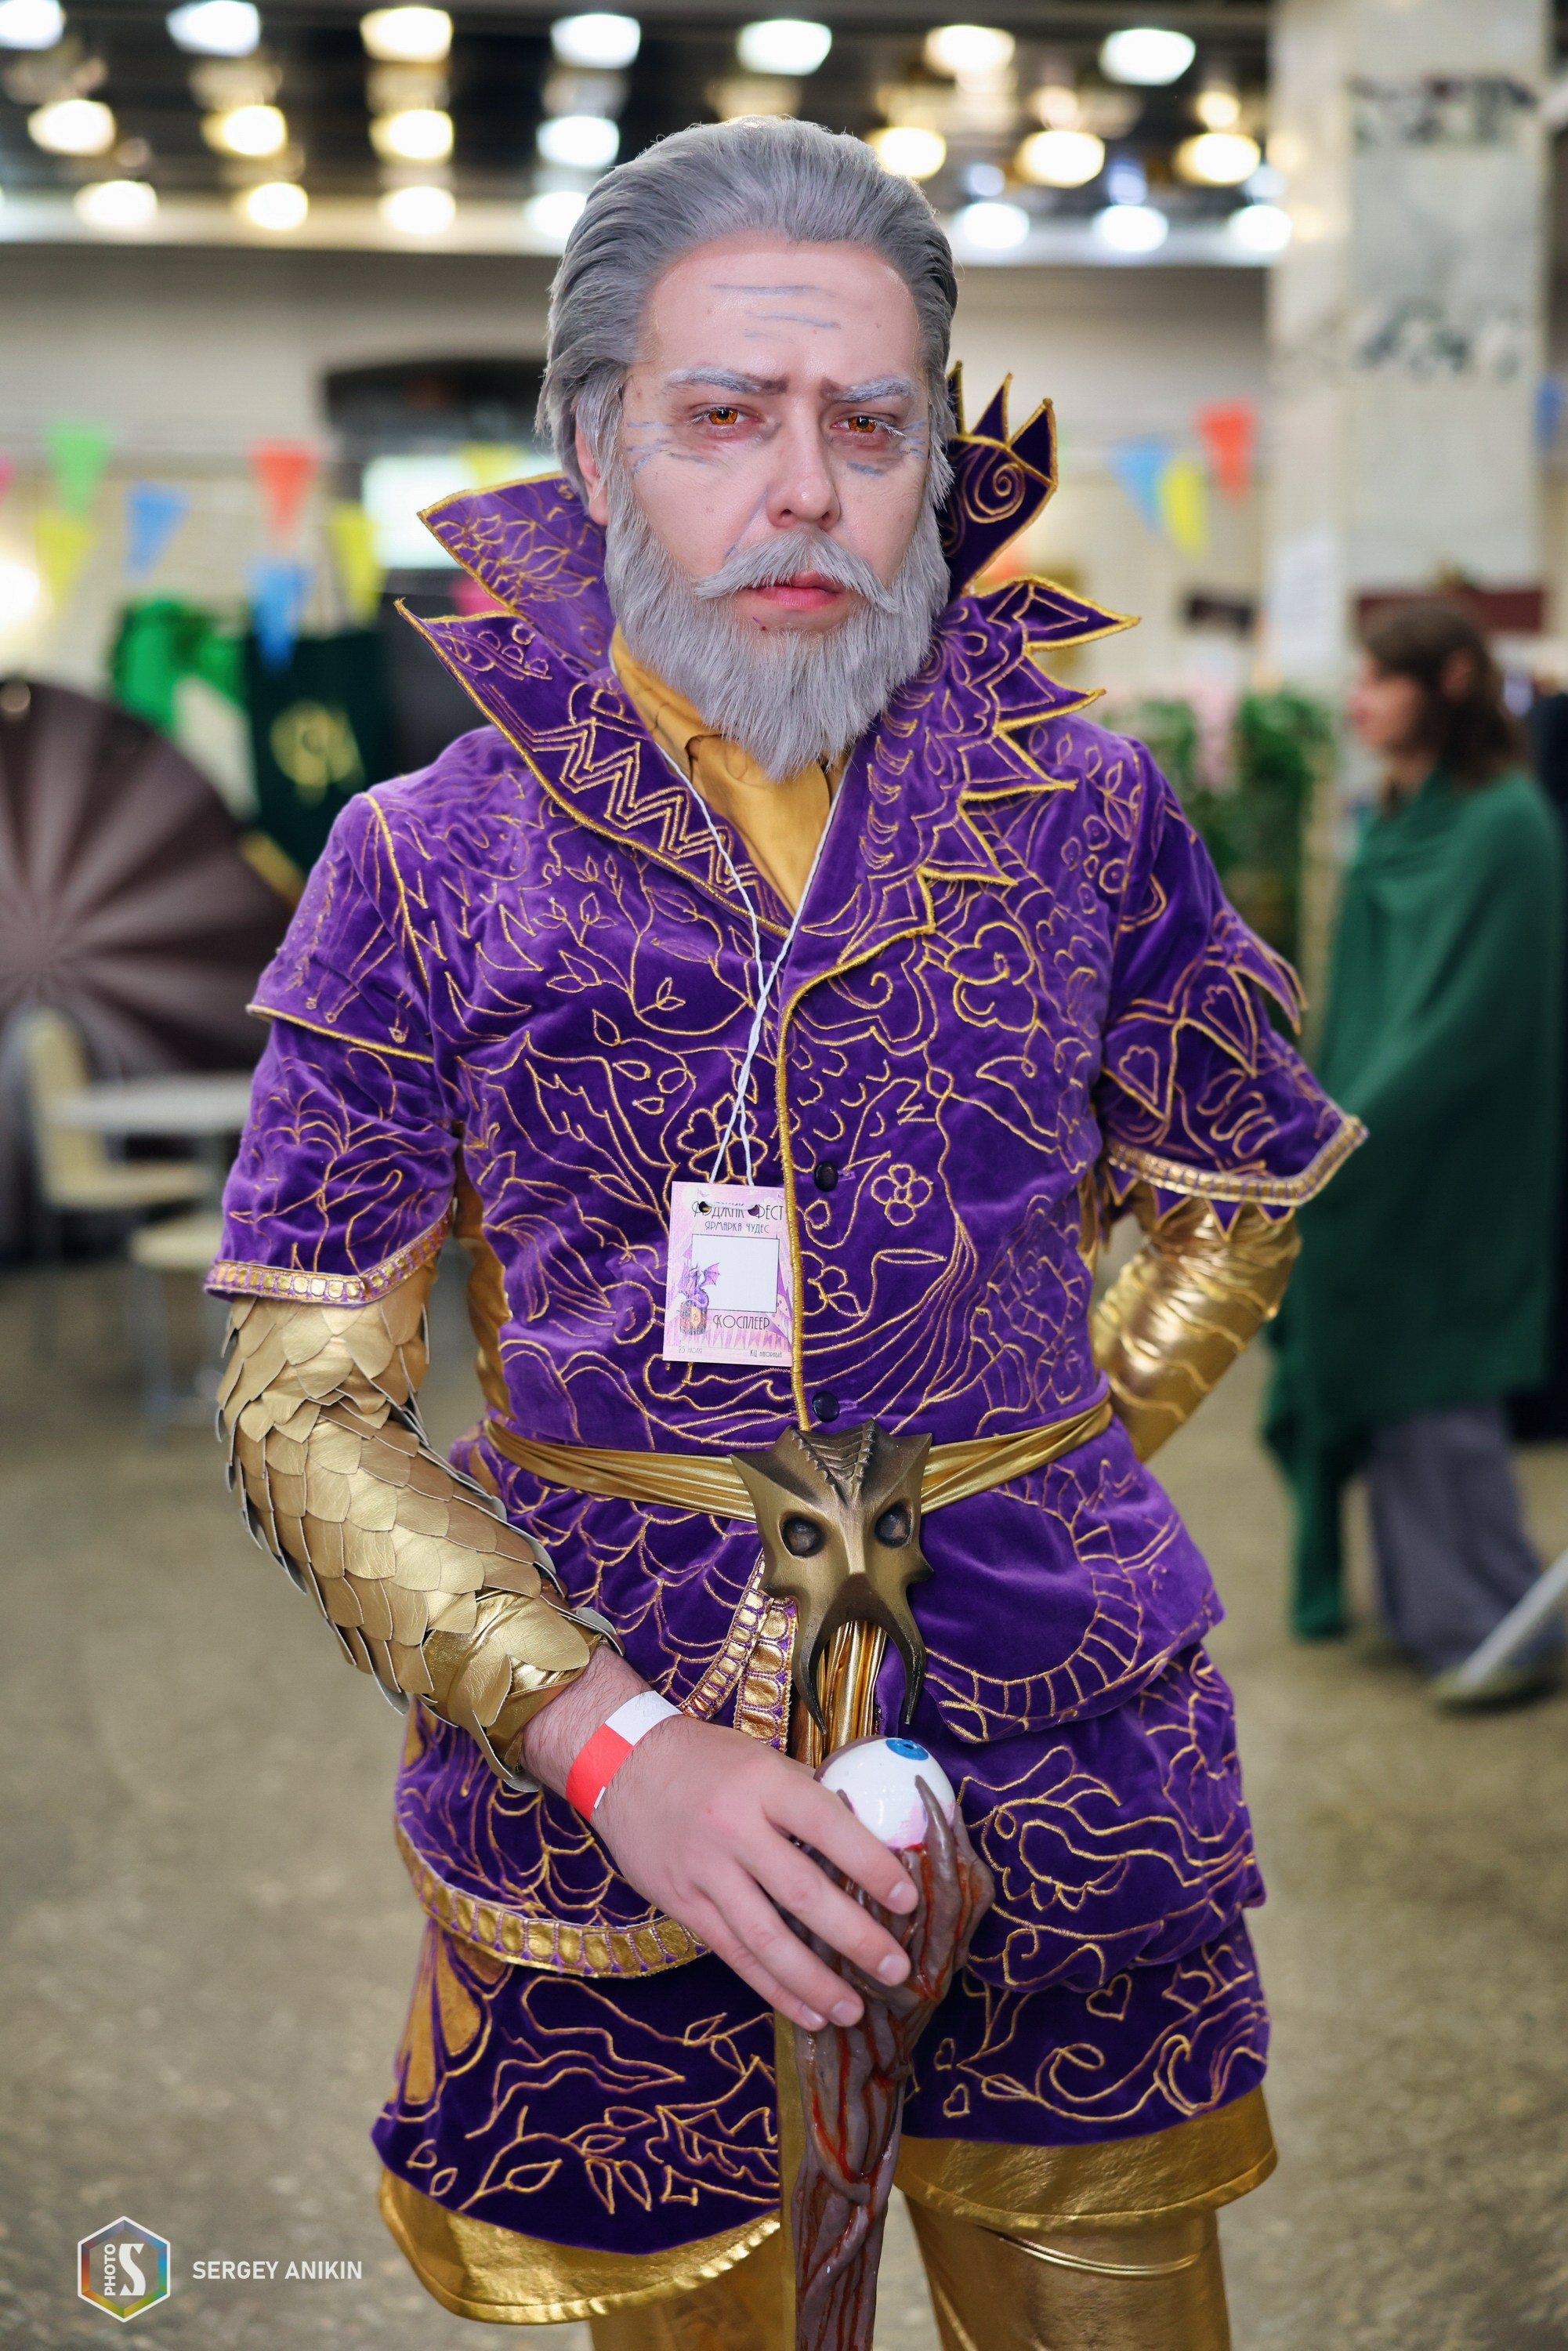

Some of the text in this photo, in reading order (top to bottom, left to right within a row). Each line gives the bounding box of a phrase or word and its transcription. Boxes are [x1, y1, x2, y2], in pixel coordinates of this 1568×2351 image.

[704, 1221, 769, 1233] ЯРМАРКА ЧУДЕС
[713, 1314, 770, 1329] КОСПЛЕЕР
